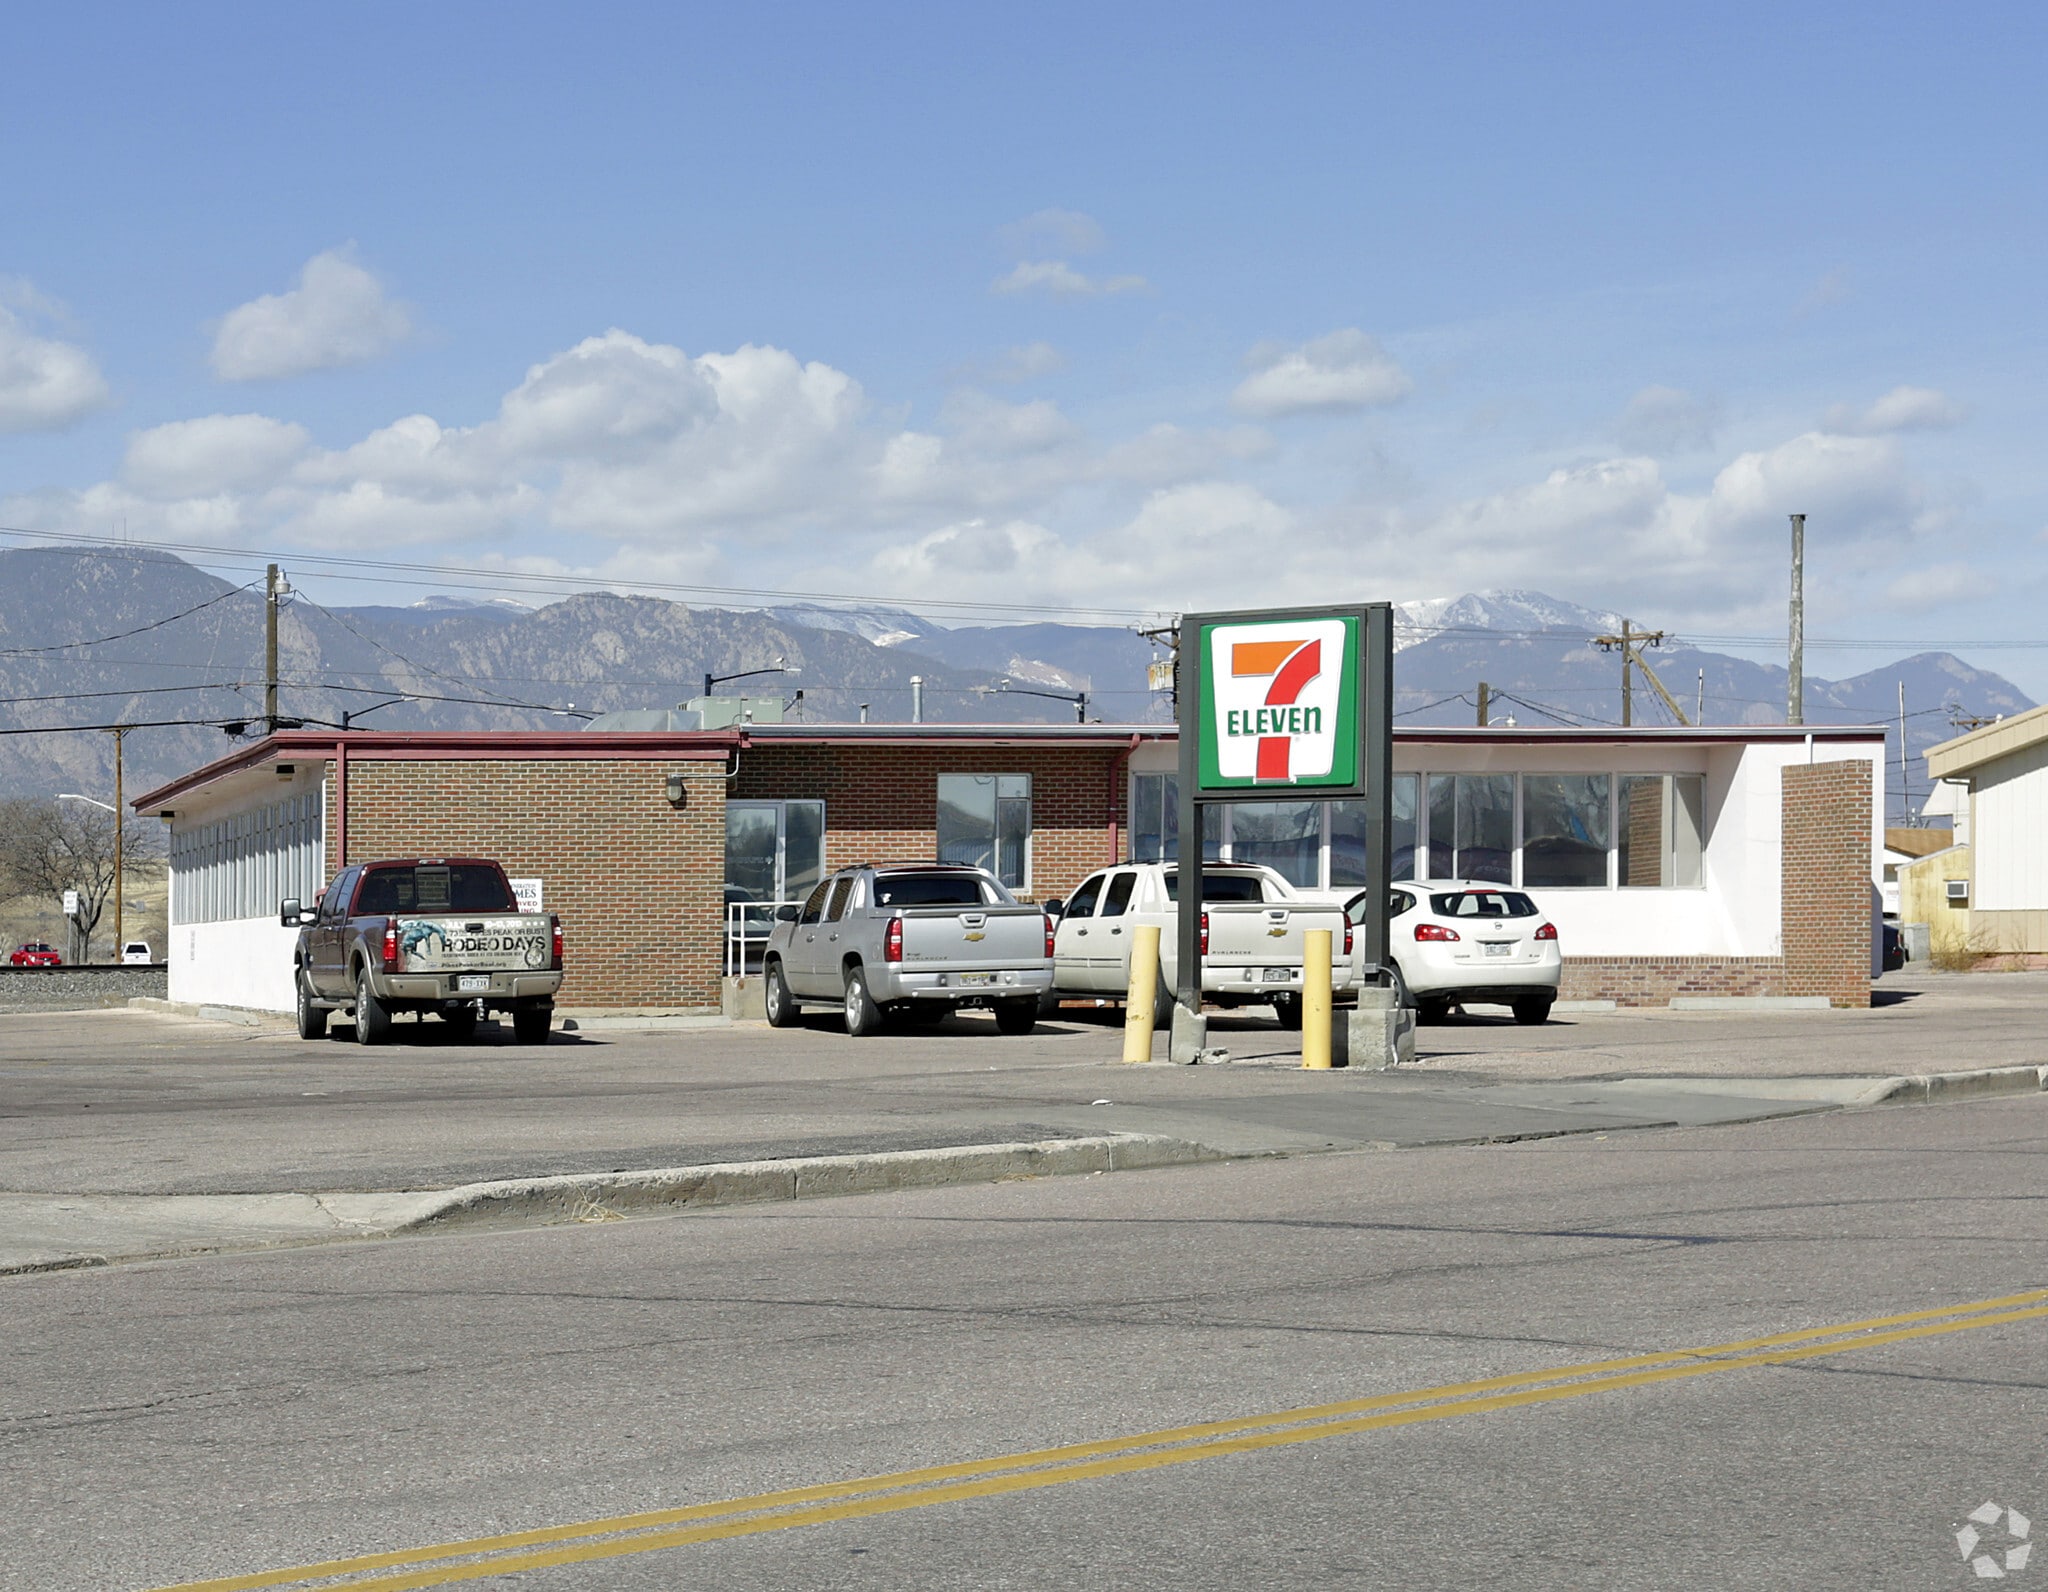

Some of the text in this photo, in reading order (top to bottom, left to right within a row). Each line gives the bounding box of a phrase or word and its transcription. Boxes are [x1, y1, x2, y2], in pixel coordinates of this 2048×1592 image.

[1232, 638, 1321, 780] 7
[515, 889, 537, 899] MES
[493, 928, 512, 936] PEAK
[526, 927, 546, 935] BUST
[442, 936, 545, 952] RODEO DAYS
